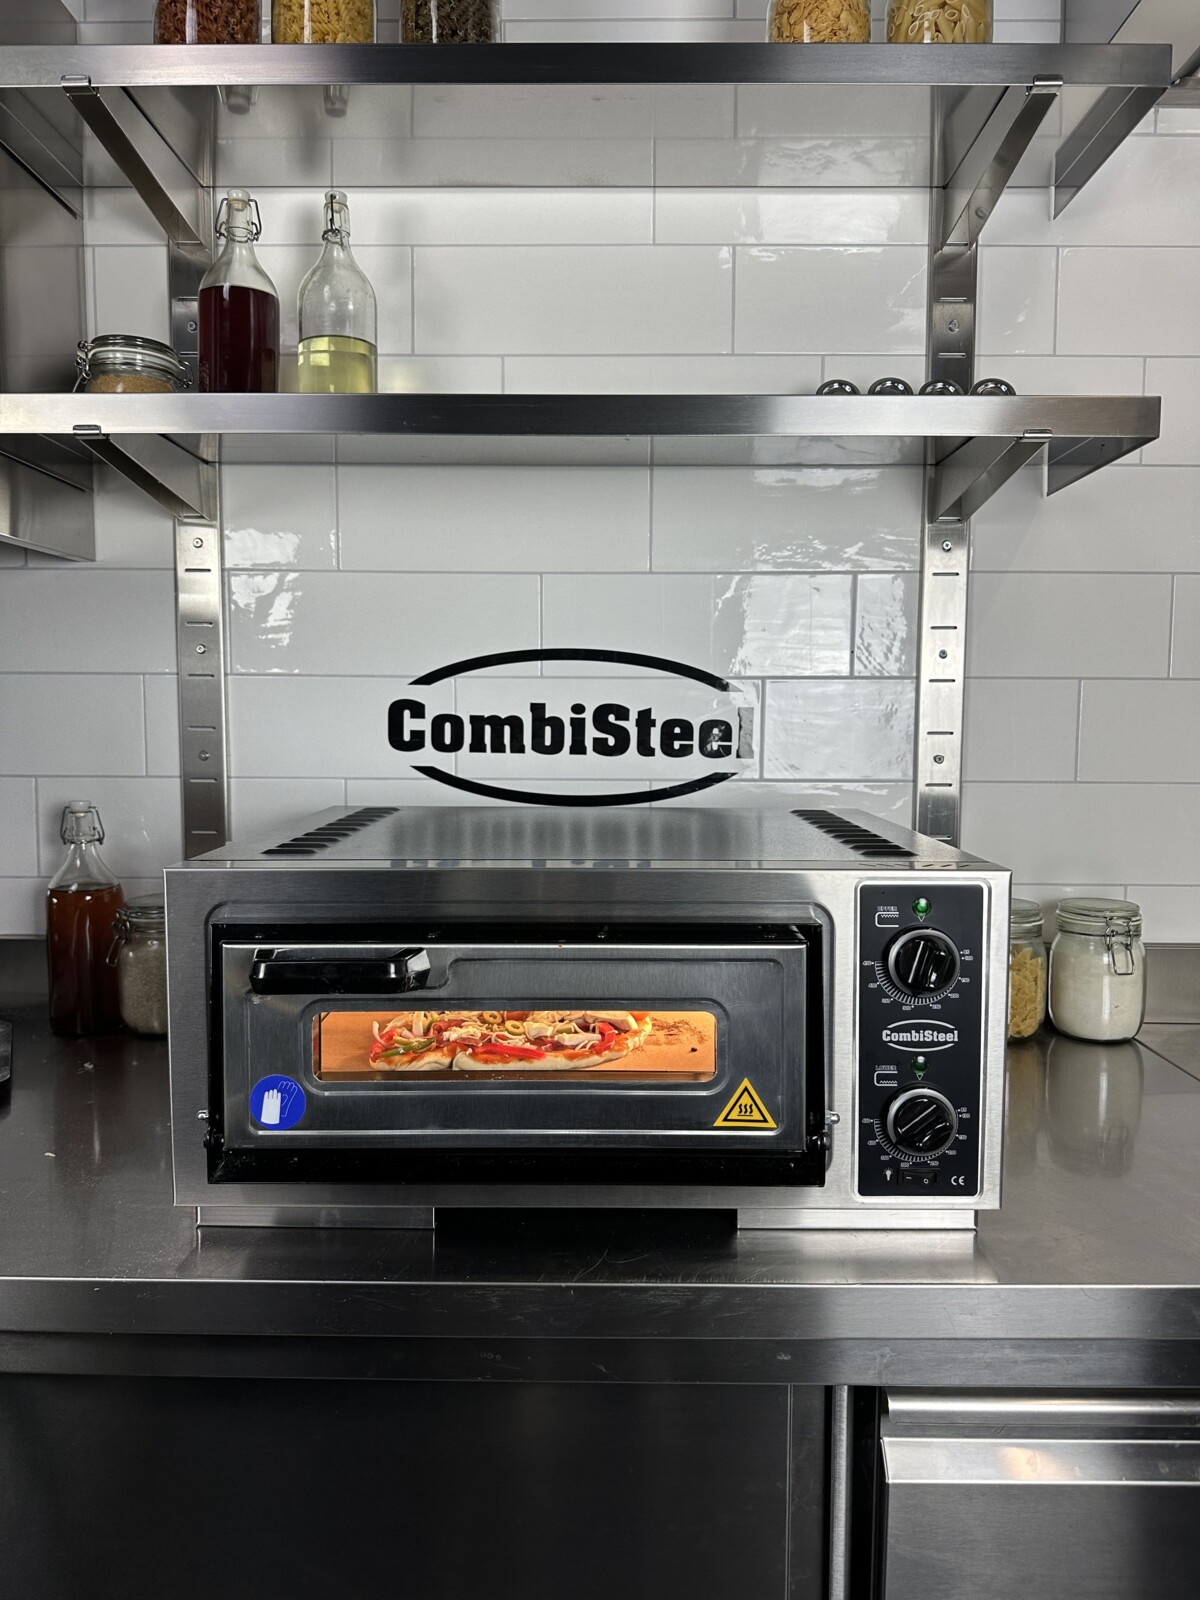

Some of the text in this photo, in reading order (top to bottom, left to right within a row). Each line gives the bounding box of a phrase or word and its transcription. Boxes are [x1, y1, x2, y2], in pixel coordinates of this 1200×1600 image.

[387, 698, 754, 759] CombiSteel
[882, 1030, 958, 1042] CombiSteel
[951, 1176, 964, 1185] CE
